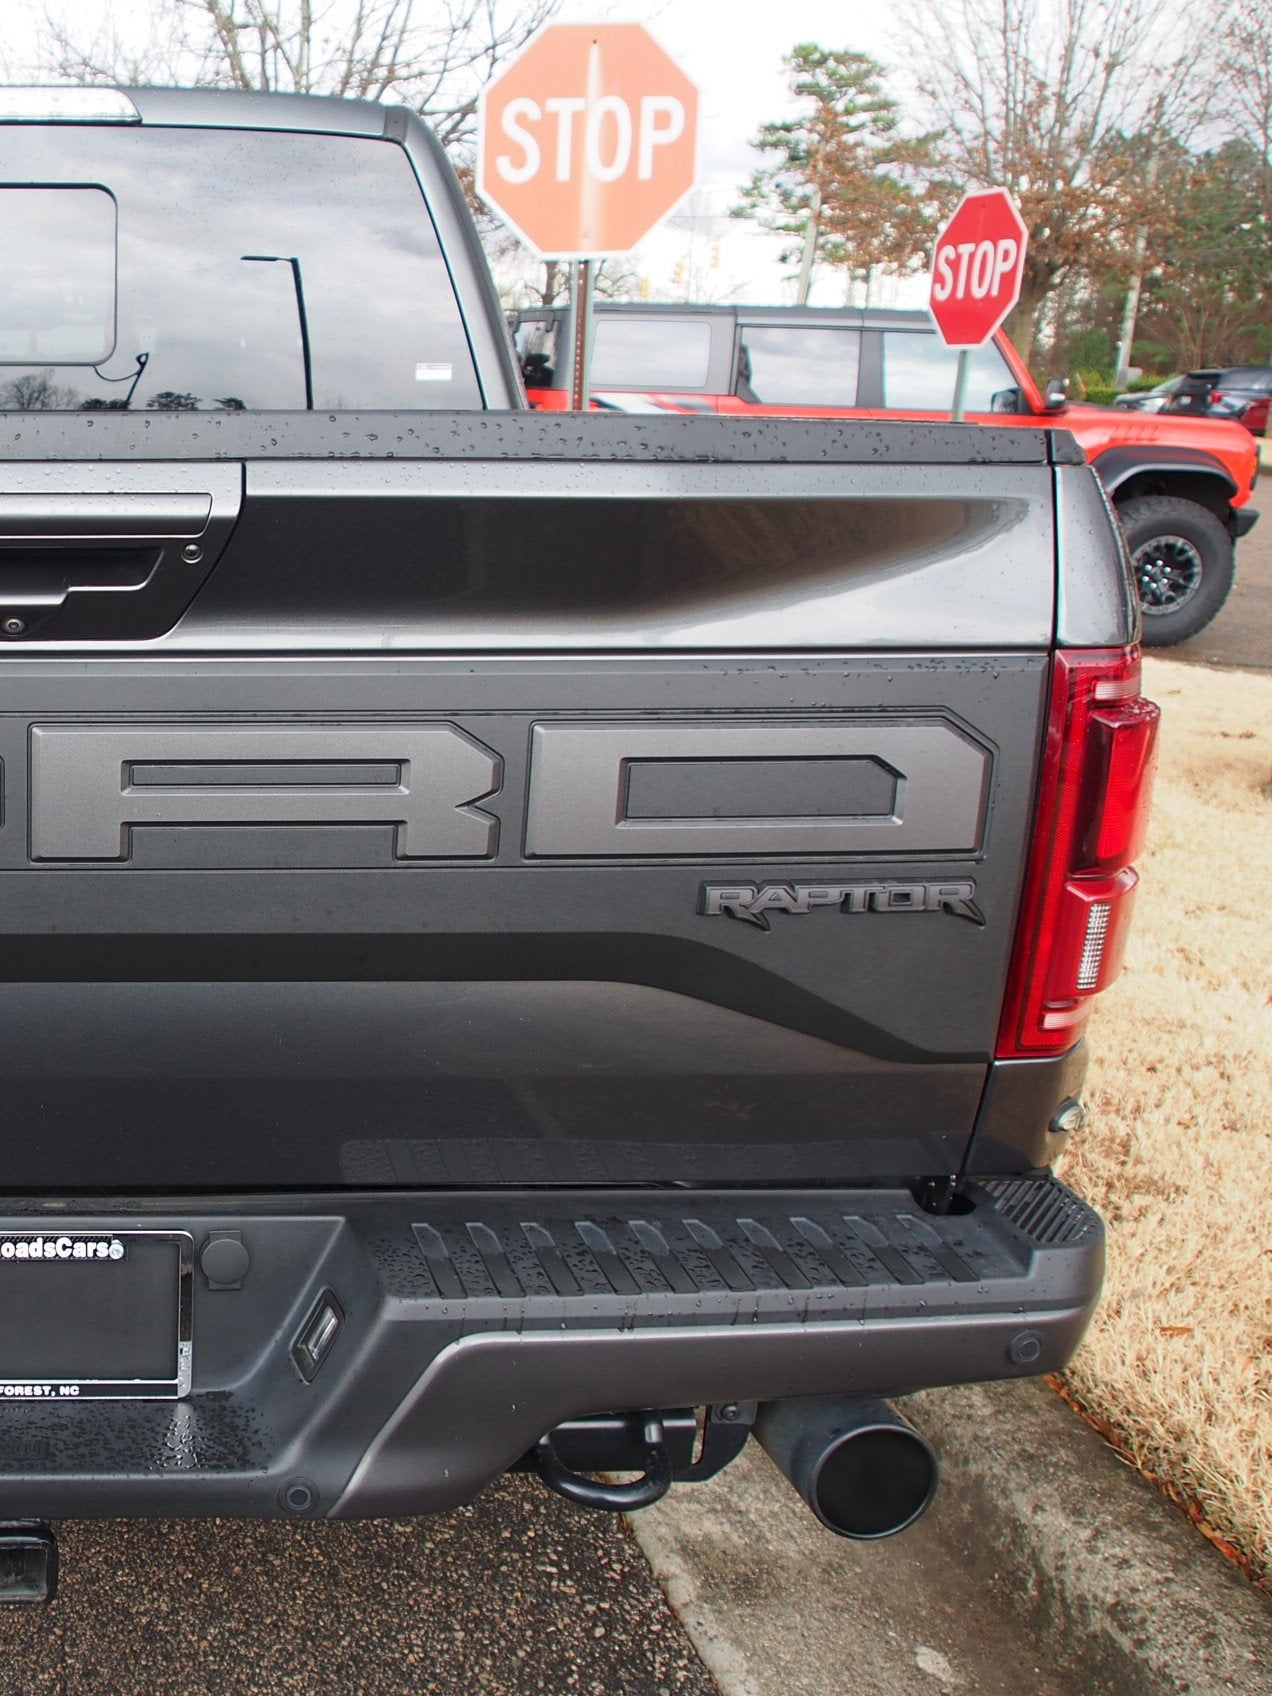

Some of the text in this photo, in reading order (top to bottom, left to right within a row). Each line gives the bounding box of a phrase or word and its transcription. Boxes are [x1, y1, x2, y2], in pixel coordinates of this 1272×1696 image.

[495, 95, 685, 184] STOP
[933, 238, 1017, 301] STOP
[697, 876, 986, 931] RAPTOR
[59, 1385, 80, 1396] NC
